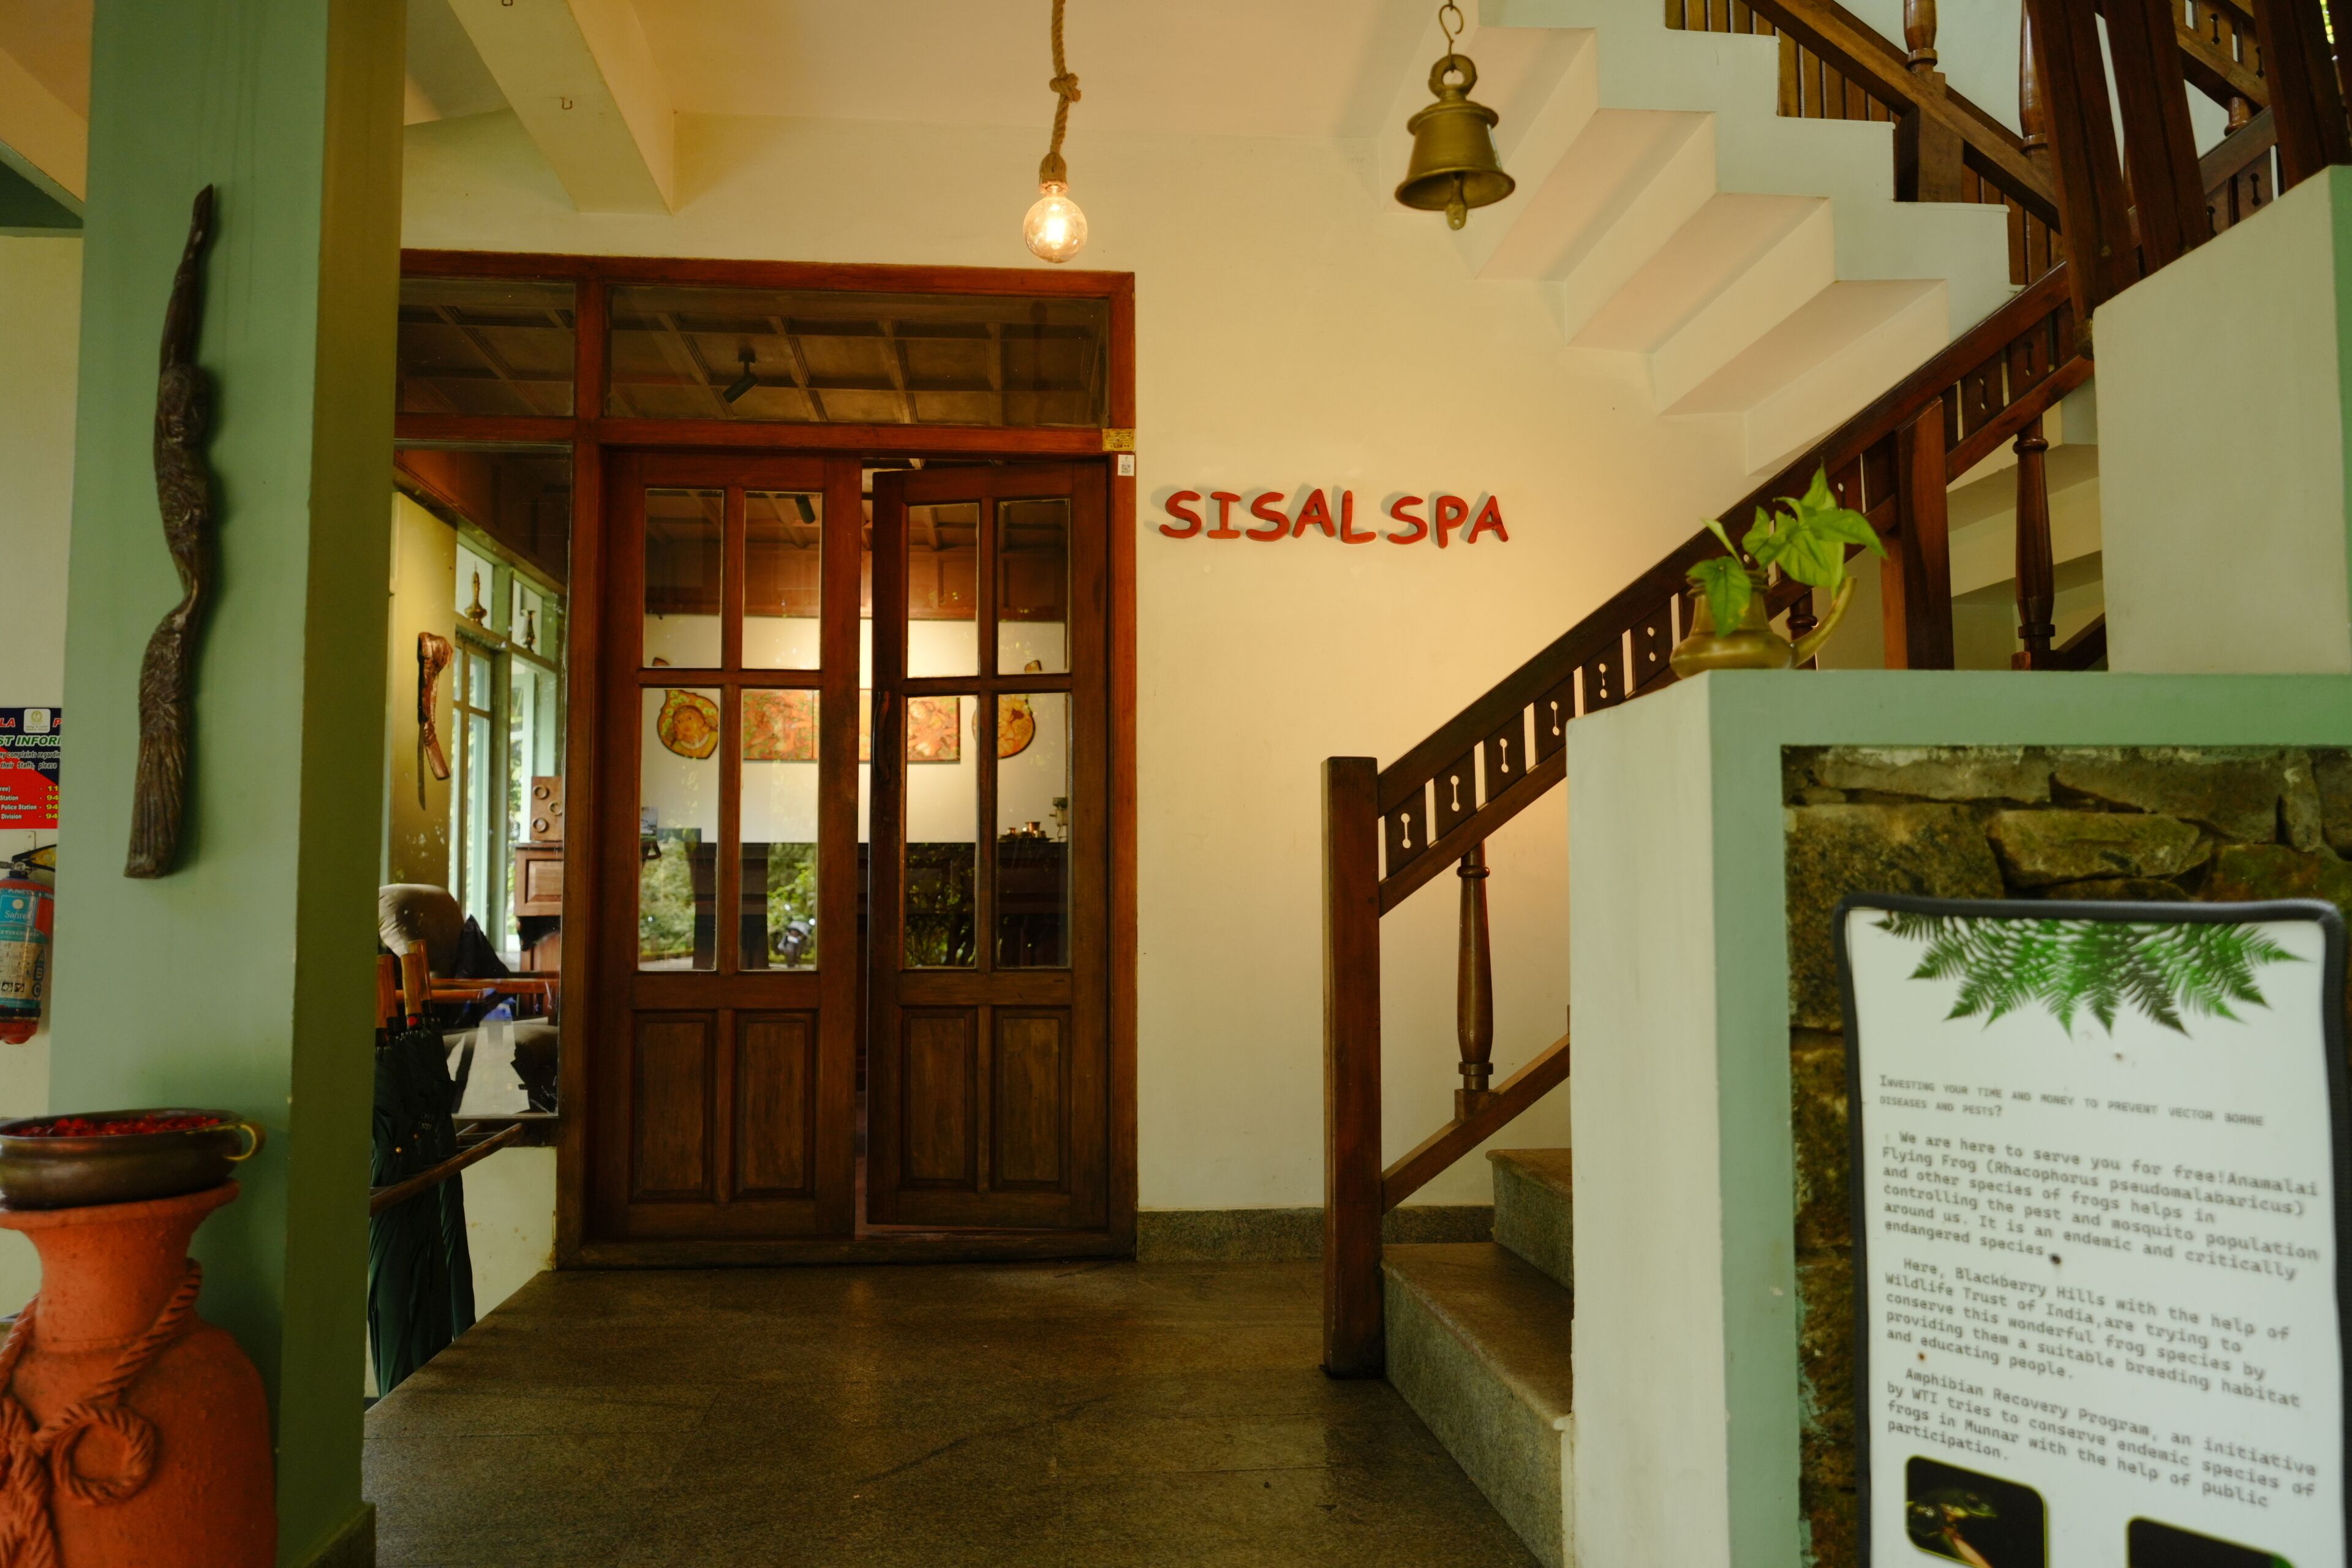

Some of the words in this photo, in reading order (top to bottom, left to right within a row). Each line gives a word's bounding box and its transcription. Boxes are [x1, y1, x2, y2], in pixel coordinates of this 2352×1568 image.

[17, 761, 36, 770] Staffs,
[38, 761, 58, 771] please
[1882, 1146, 1933, 1167] Flying
[1942, 1154, 1977, 1174] Frog
[1899, 1131, 1917, 1144] We
[1925, 1136, 1951, 1148] are
[1960, 1137, 1996, 1155] here
[2005, 1144, 2023, 1158] to
[2033, 1150, 2081, 1166] serve
[2090, 1157, 2121, 1171] you
[2131, 1159, 2162, 1176] for
[1883, 1167, 1909, 1179] and
[1917, 1170, 1959, 1186] other
[1969, 1178, 2032, 1197] species
[2042, 1188, 2060, 1200] of
[2071, 1190, 2120, 1212] frogs
[2130, 1199, 2182, 1221] helps
[2195, 1208, 2215, 1224] in
[1883, 1183, 1978, 1211] controlling
[1987, 1198, 2015, 1213] the
[2024, 1205, 2061, 1221] pest
[2071, 1213, 2101, 1227] and
[2111, 1219, 2195, 1241] mosquito
[2206, 1233, 2320, 1261] population
[1885, 1221, 1970, 1244] endangered
[1884, 1202, 1935, 1219] around
[1943, 1212, 1967, 1224] us.
[1979, 1215, 1996, 1230] It
[2007, 1219, 2024, 1234] is
[2034, 1226, 2053, 1238] an
[2063, 1231, 2132, 1251] endemic
[2143, 1244, 2174, 1259] and
[2185, 1251, 2296, 1281] critically
[1885, 1272, 1954, 1297] Wildlife
[1962, 1286, 2007, 1307] Trust
[2017, 1299, 2036, 1312] of
[2145, 1322, 2209, 1350] trying
[2220, 1337, 2242, 1353] to
[1886, 1293, 1954, 1315] conserve
[1962, 1306, 1999, 1324] this
[2008, 1317, 2094, 1344] wonderful
[2105, 1334, 2146, 1358] frog
[2157, 1347, 2231, 1372] species
[2243, 1362, 2266, 1382] by
[1904, 1257, 1944, 1280] Here,
[1955, 1267, 2046, 1298] Blackberry
[2056, 1286, 2106, 1306] Hills
[2116, 1298, 2157, 1316] with
[2168, 1306, 2200, 1324] the
[2211, 1314, 2256, 1337] help
[2267, 1326, 2290, 1340] of
[1887, 1329, 1912, 1343] and
[1920, 1336, 2000, 1366] educating
[2009, 1356, 2072, 1379] people.
[1887, 1311, 1964, 1340] providing
[1972, 1327, 2009, 1346] them
[2018, 1339, 2027, 1350] a
[2037, 1343, 2115, 1368] suitable
[2125, 1358, 2211, 1392] breeding
[2222, 1379, 2300, 1408] habitat
[1887, 1381, 1904, 1399] by
[1912, 1387, 1937, 1404] WTI
[1947, 1396, 1991, 1418] tries
[2000, 1409, 2019, 1425] to
[2029, 1418, 2106, 1446] conserve
[2117, 1440, 2189, 1467] endemic
[2202, 1461, 2280, 1490] species
[2292, 1482, 2315, 1497] of
[1887, 1399, 1929, 1422] frogs
[1939, 1412, 1956, 1428] in
[1964, 1419, 2019, 1444] Munnar
[2029, 1437, 2067, 1456] with
[2077, 1447, 2107, 1467] the
[2117, 1457, 2160, 1482] help
[2169, 1473, 2190, 1487] of
[2202, 1482, 2268, 1508] public
[1888, 1420, 2007, 1460] participation.
[1905, 1368, 1984, 1397] Amphibian
[1993, 1387, 2068, 1420] Recovery
[2078, 1408, 2157, 1441] Program,
[2171, 1433, 2192, 1446] an
[2204, 1437, 2317, 1477] initiative
